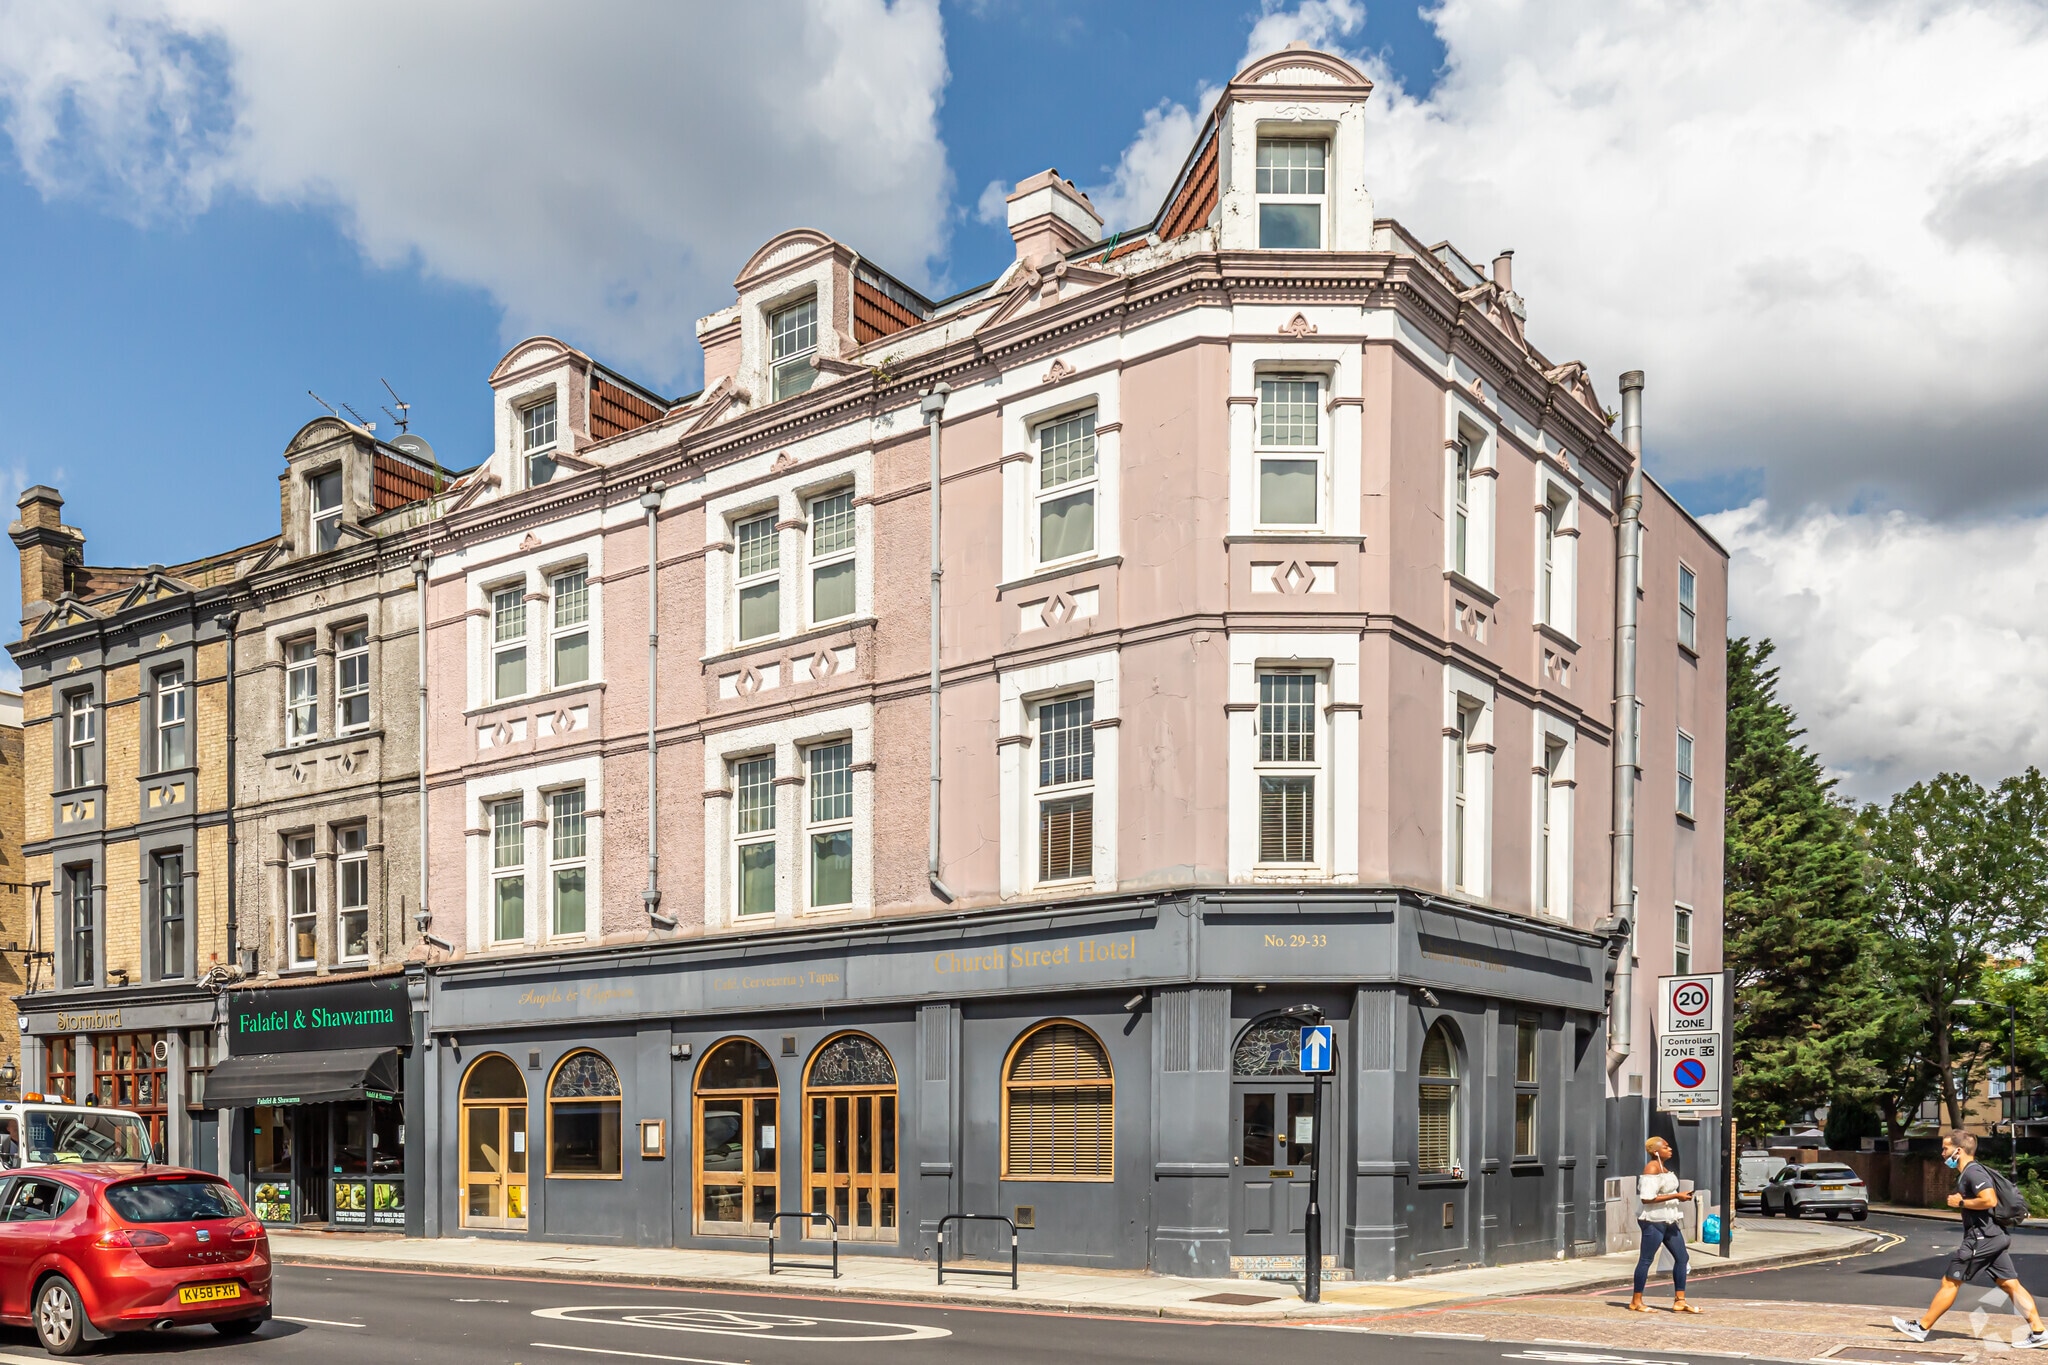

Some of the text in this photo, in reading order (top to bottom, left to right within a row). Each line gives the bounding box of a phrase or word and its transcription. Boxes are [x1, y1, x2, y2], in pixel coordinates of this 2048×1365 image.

[1264, 934, 1327, 947] No. 29-33
[933, 936, 1136, 974] Church Street Hotel
[799, 975, 806, 988] y
[808, 971, 840, 987] Tapas
[518, 986, 562, 1008] Angels
[1679, 991, 1704, 1006] 20
[57, 1008, 122, 1031] Stormbird
[239, 1007, 394, 1033] Falafel & Shawarma
[1675, 1019, 1705, 1028] ZONE
[1668, 1037, 1712, 1045] Controlled
[1664, 1046, 1714, 1057] ZONE EC
[184, 1285, 236, 1301] KV58 FXH
